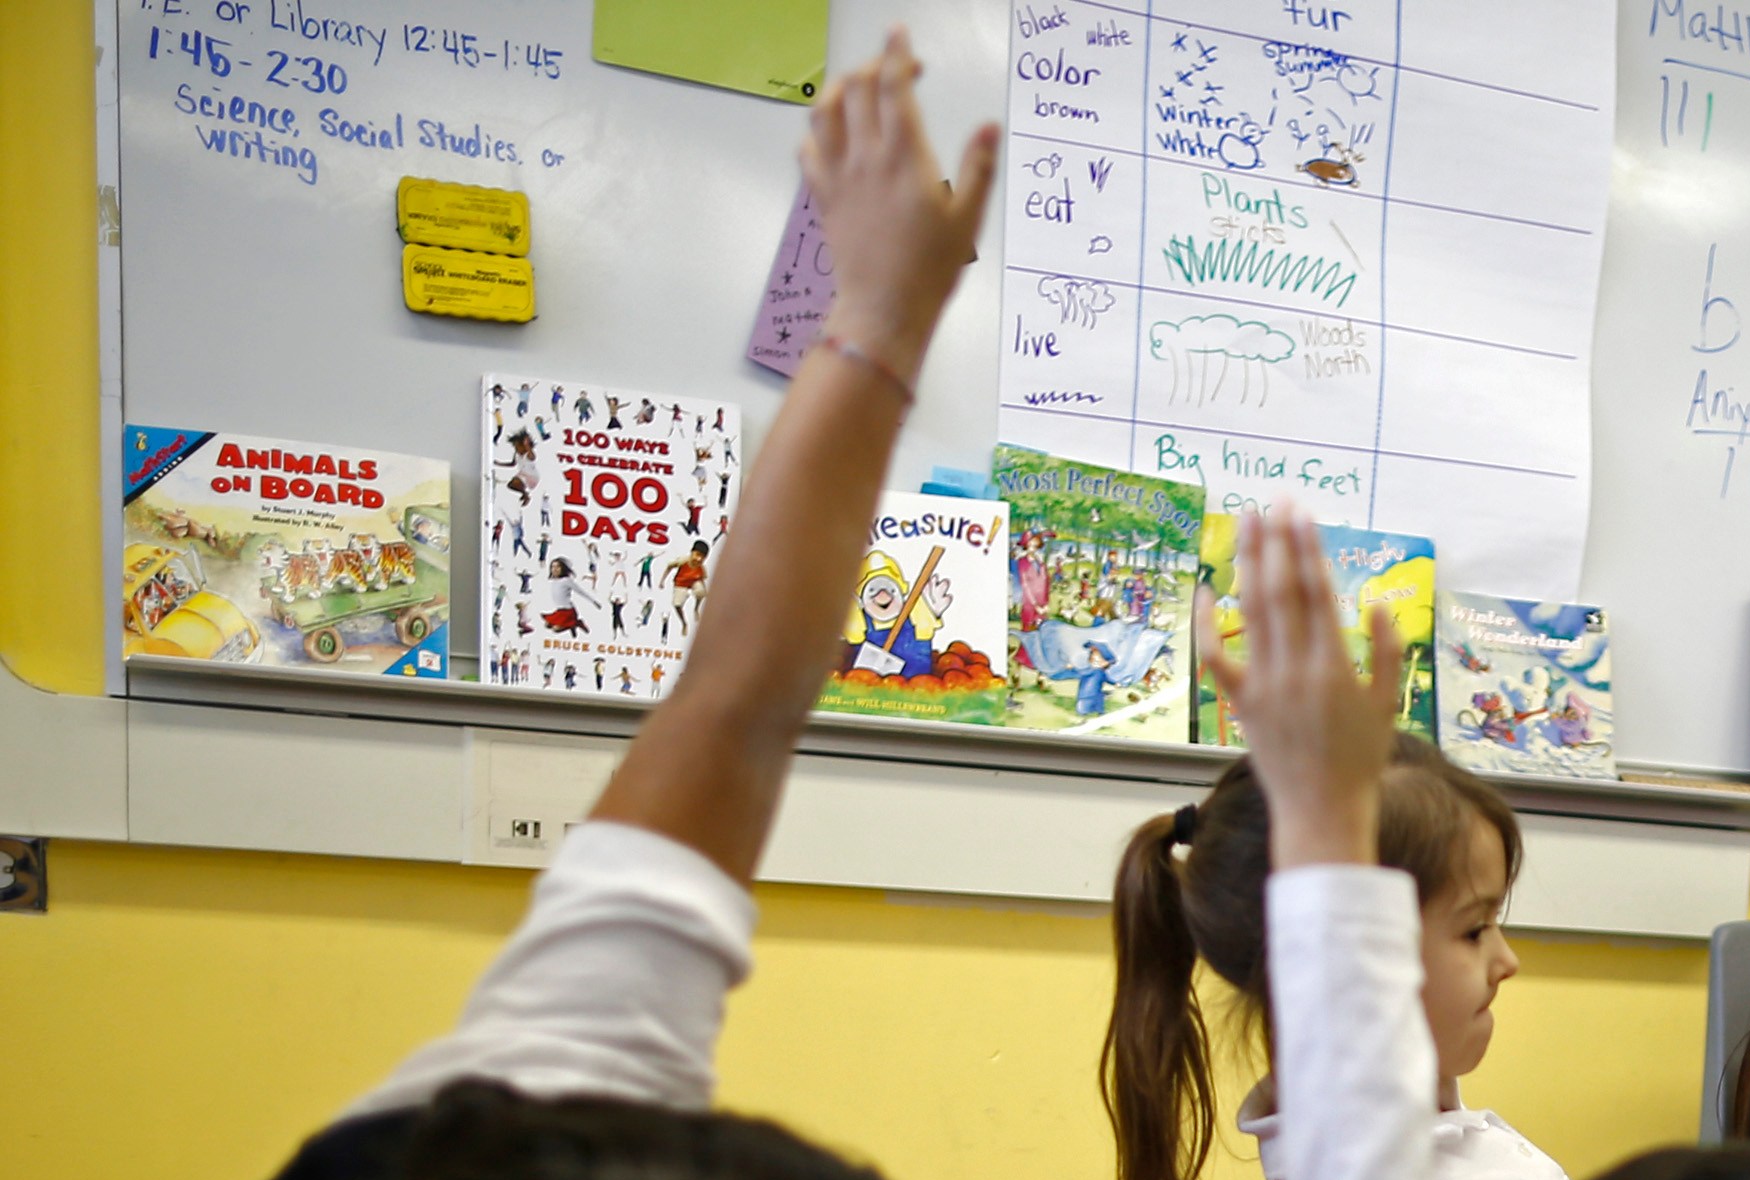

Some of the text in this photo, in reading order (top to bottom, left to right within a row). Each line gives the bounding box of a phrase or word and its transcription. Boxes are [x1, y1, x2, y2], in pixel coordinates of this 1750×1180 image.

[1016, 8, 1070, 40] black
[1282, 0, 1353, 33] fur
[216, 1, 251, 24] or
[270, 0, 387, 66] Library
[403, 23, 564, 80] 12:45-1:45
[1034, 93, 1102, 125] brown
[318, 107, 405, 151] Social
[541, 149, 565, 168] or
[1024, 178, 1076, 224] eat
[1202, 172, 1309, 229] Plants
[1014, 314, 1061, 358] live
[1304, 351, 1372, 381] North
[563, 428, 669, 455] 100 WAYS
[217, 443, 378, 480] ANIMALS
[577, 454, 674, 475] CELEBRATE
[1153, 434, 1363, 496] Big hind feet
[210, 475, 385, 509] ON BOARD
[563, 468, 669, 513] 100
[999, 467, 1202, 540] Most Perfect Spot
[562, 510, 670, 545] DAYS
[867, 511, 1004, 556] reasure!
[1451, 605, 1517, 627] Winter
[543, 638, 683, 661] BRUCE GOLDSTONE
[1468, 624, 1585, 651] Wonderland
